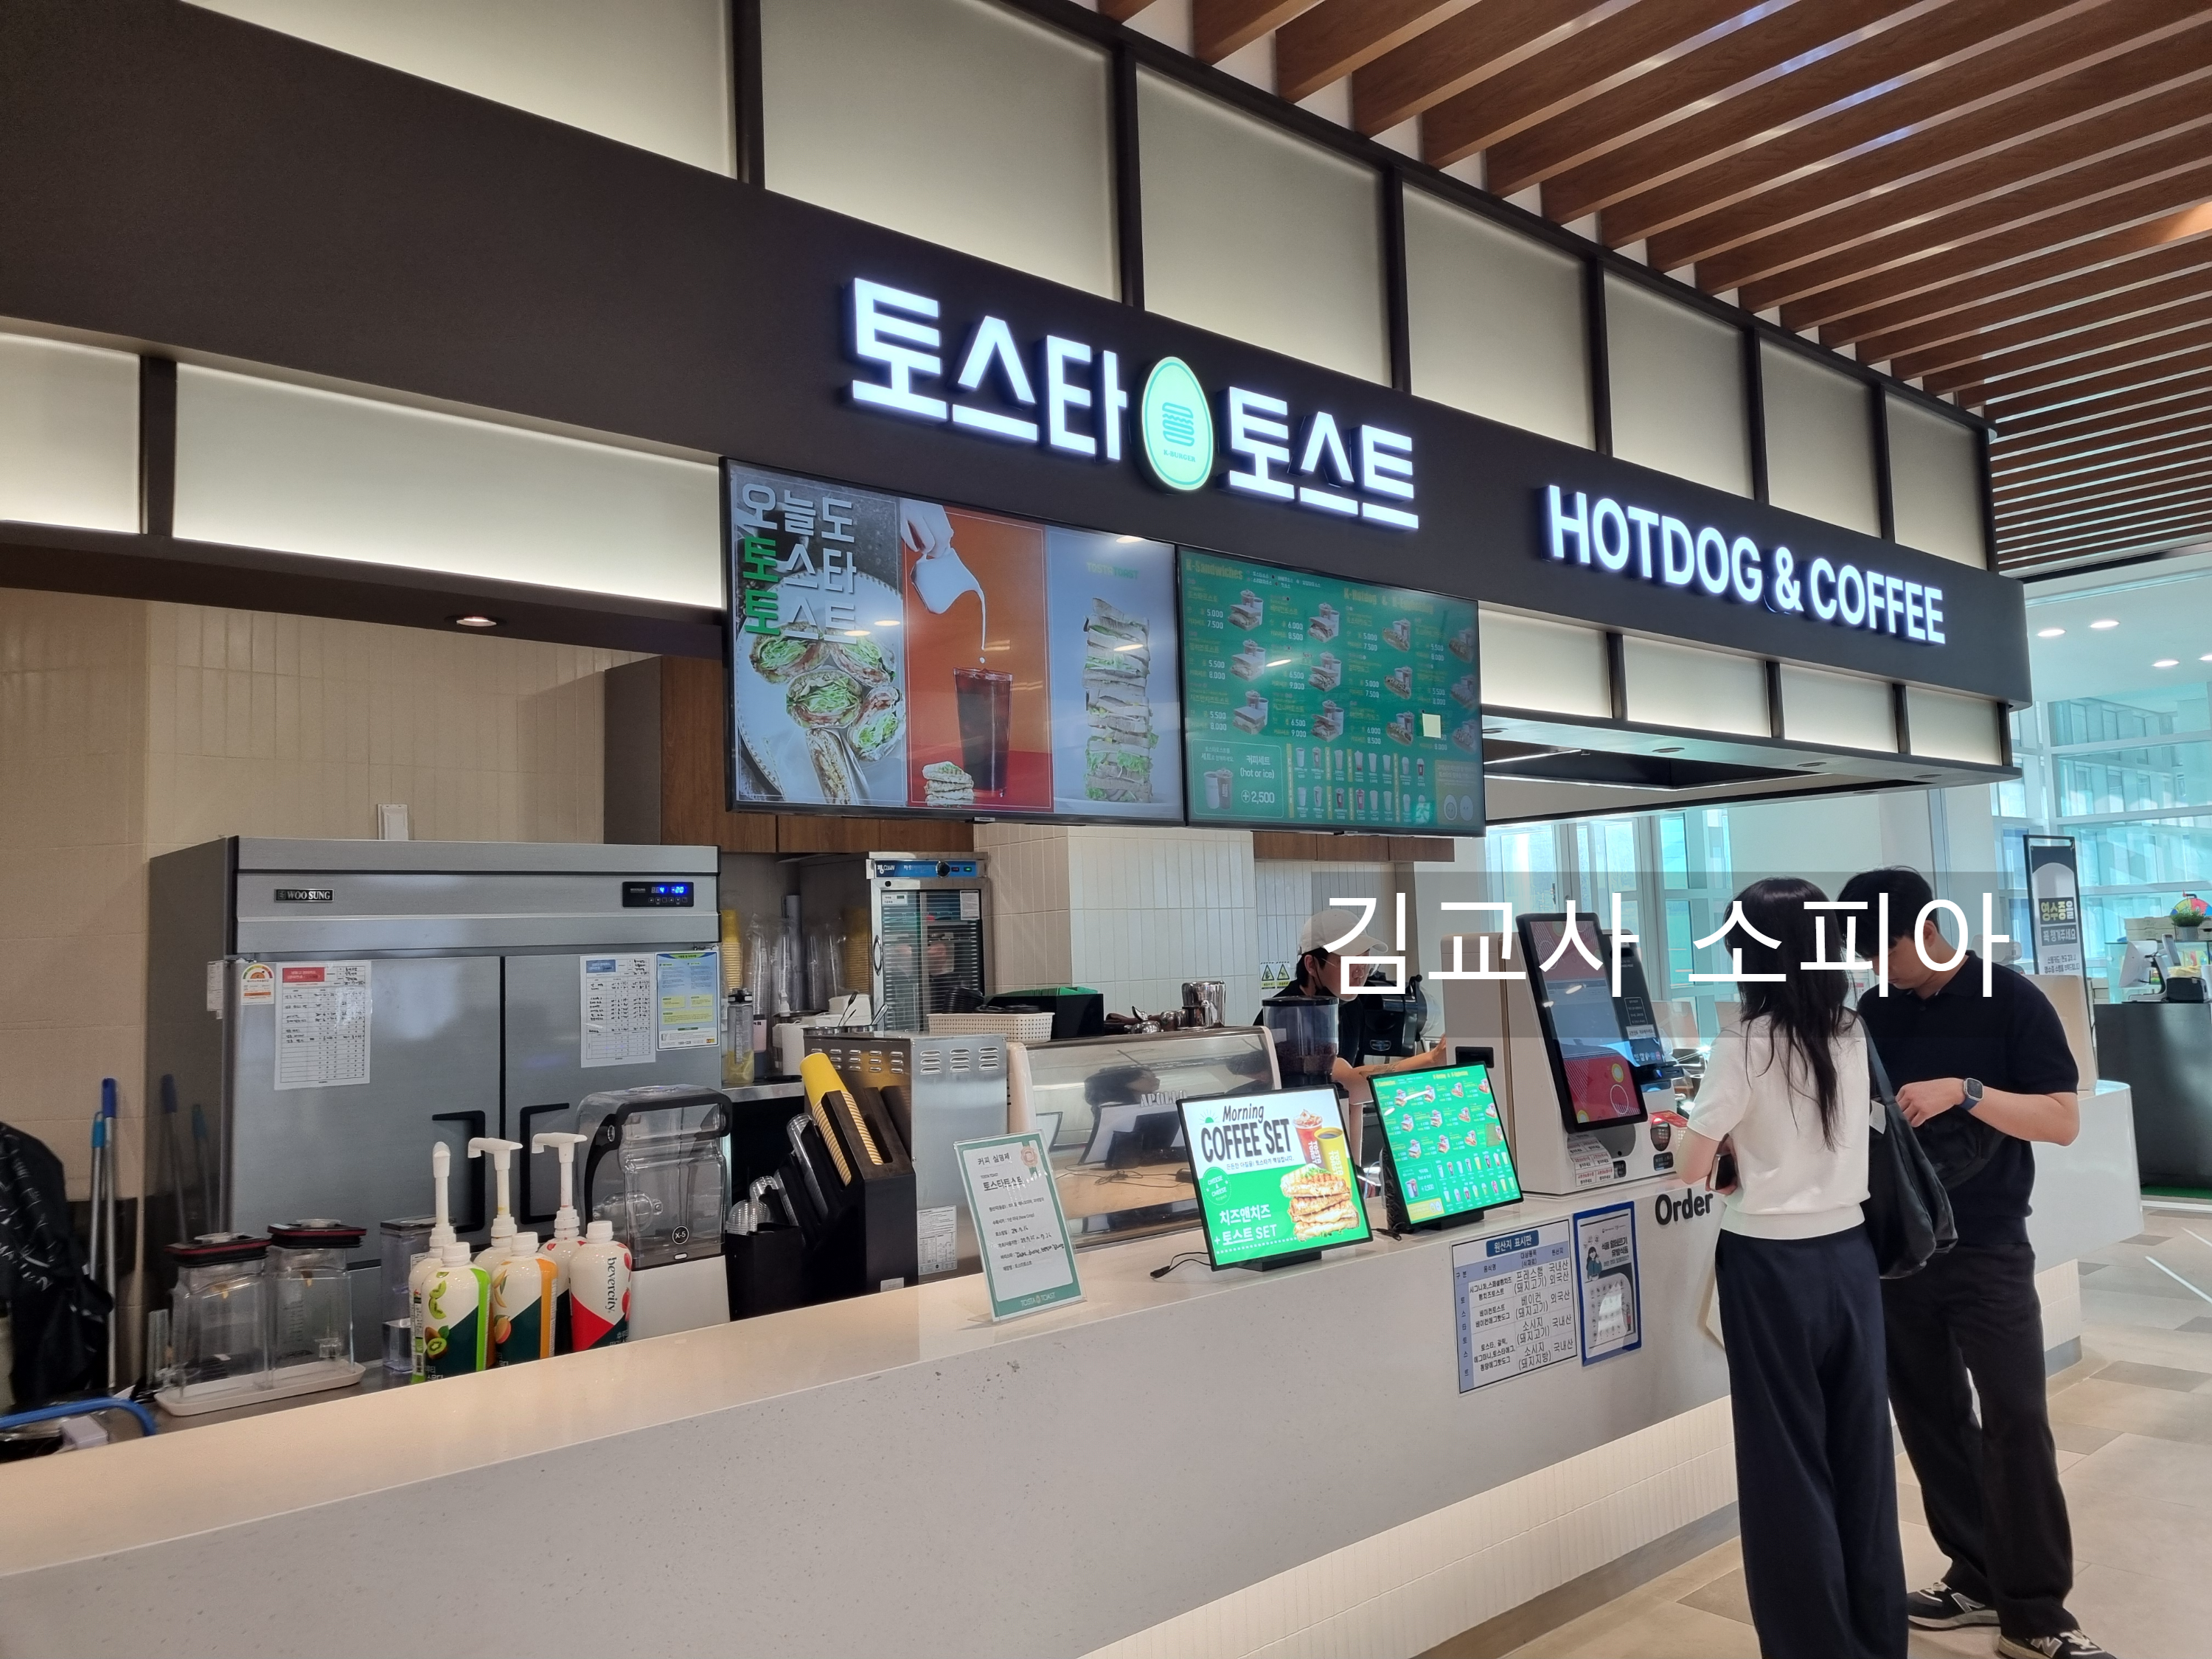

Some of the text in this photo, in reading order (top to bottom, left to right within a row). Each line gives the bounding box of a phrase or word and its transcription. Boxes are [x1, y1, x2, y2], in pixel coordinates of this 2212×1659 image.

[852, 277, 1419, 531] 토스타 토스트
[1164, 449, 1196, 463] K-BURGER
[742, 483, 855, 543] 오늘도
[742, 535, 858, 594] 토스타
[1549, 484, 1946, 645] HOTDOG & COFFEE
[744, 588, 858, 645] 토스트
[1246, 754, 1271, 765] 커피세트
[1239, 767, 1275, 779] (hot or ice)
[1251, 790, 1276, 804] 2,500
[287, 891, 331, 900] WOO SUNG
[2040, 900, 2074, 922] 영수증을
[2050, 928, 2076, 942] 챙겨주세요
[1222, 1103, 1265, 1124] Morning
[1200, 1118, 1292, 1163] COFFEE SET
[978, 1152, 1010, 1166] 커피 실명제
[1211, 1186, 1228, 1197] CHEESE
[1655, 1188, 1714, 1225] Order
[1219, 1204, 1272, 1226] 치즈앤치즈
[675, 1231, 686, 1239] X-5
[1222, 1227, 1254, 1246] 토스트
[1255, 1223, 1277, 1239] SET
[1494, 1235, 1533, 1253] 원산지 표시판
[1551, 1247, 1564, 1256] 원산지
[1484, 1263, 1497, 1273] 음식명
[1516, 1265, 1544, 1283] 프레스햄
[1548, 1259, 1568, 1273] 국내산
[605, 1256, 618, 1312] bevercity
[1514, 1275, 1547, 1295] (돼지고기)
[1549, 1270, 1570, 1285] 외국산
[1020, 1292, 1056, 1307] TOSTA TOAST
[1520, 1292, 1542, 1307] 베이컨
[1550, 1290, 1571, 1304] 외국산
[1515, 1300, 1548, 1320] (돼지고기)
[1523, 1316, 1543, 1332] 소시지
[1552, 1314, 1572, 1328] 국내산
[1517, 1325, 1550, 1346] (돼지고기)
[1524, 1341, 1545, 1357] 소시지
[1554, 1338, 1573, 1352] 국내산
[1518, 1350, 1551, 1371] (돼지지방)
